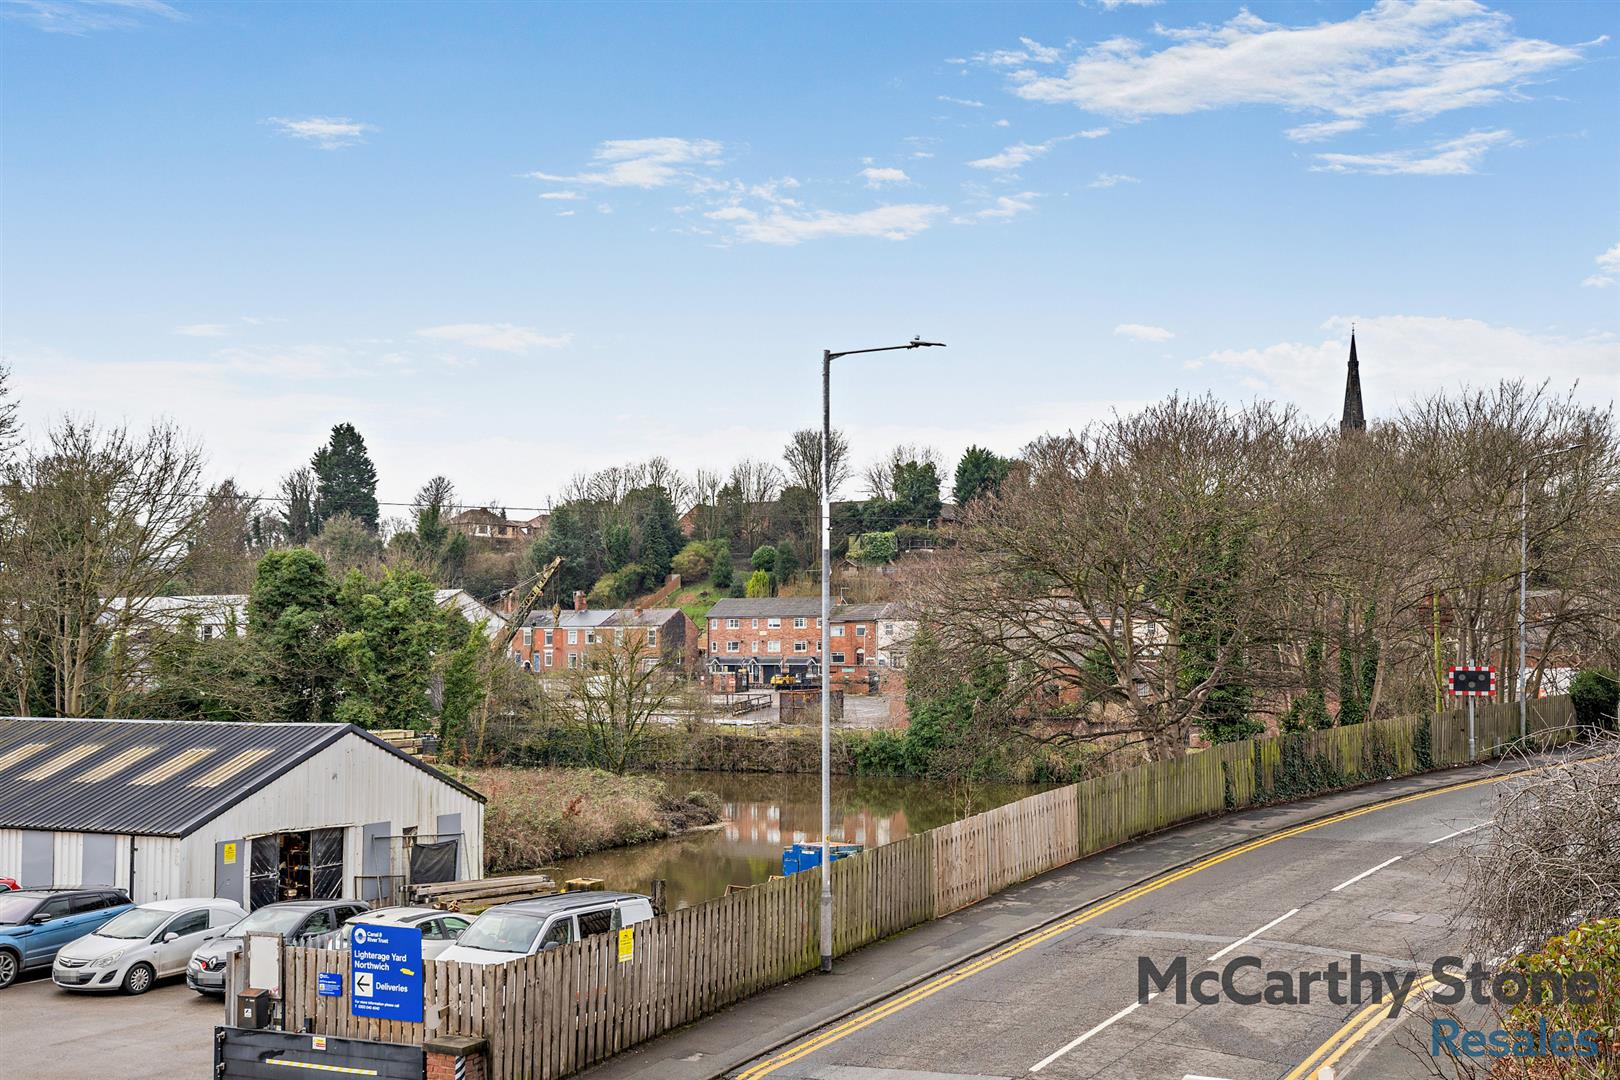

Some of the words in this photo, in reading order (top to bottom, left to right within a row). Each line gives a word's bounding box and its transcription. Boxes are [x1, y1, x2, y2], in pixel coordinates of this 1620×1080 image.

[354, 950, 390, 961] Lighterage
[391, 953, 407, 962] Yard
[354, 960, 390, 970] Northwich
[375, 982, 408, 993] Deliveries
